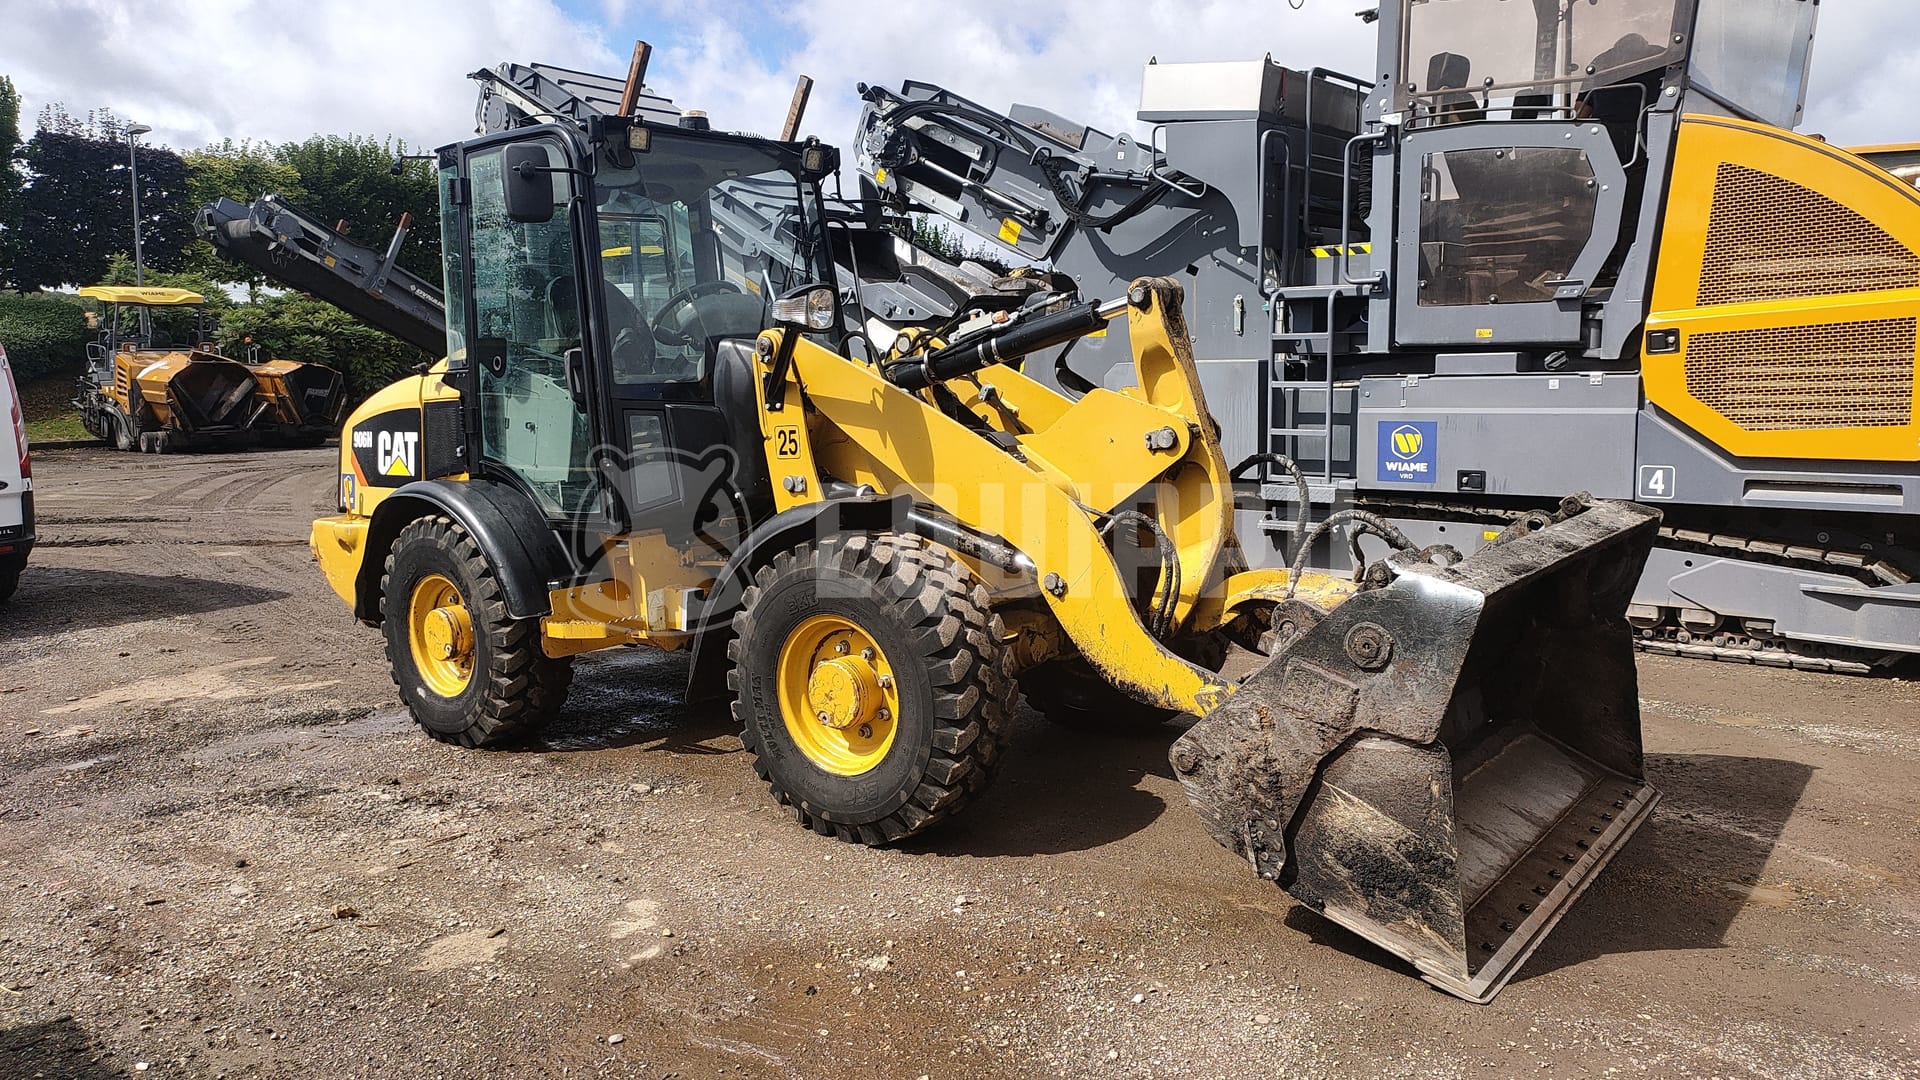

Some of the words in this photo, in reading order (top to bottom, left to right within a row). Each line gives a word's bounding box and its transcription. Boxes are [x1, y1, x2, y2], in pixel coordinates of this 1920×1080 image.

[415, 288, 445, 309] DYNAP
[353, 431, 373, 448] 906H
[778, 430, 798, 455] 25
[377, 430, 419, 476] CAT
[1385, 461, 1429, 473] WIAME
[1648, 469, 1665, 495] 4
